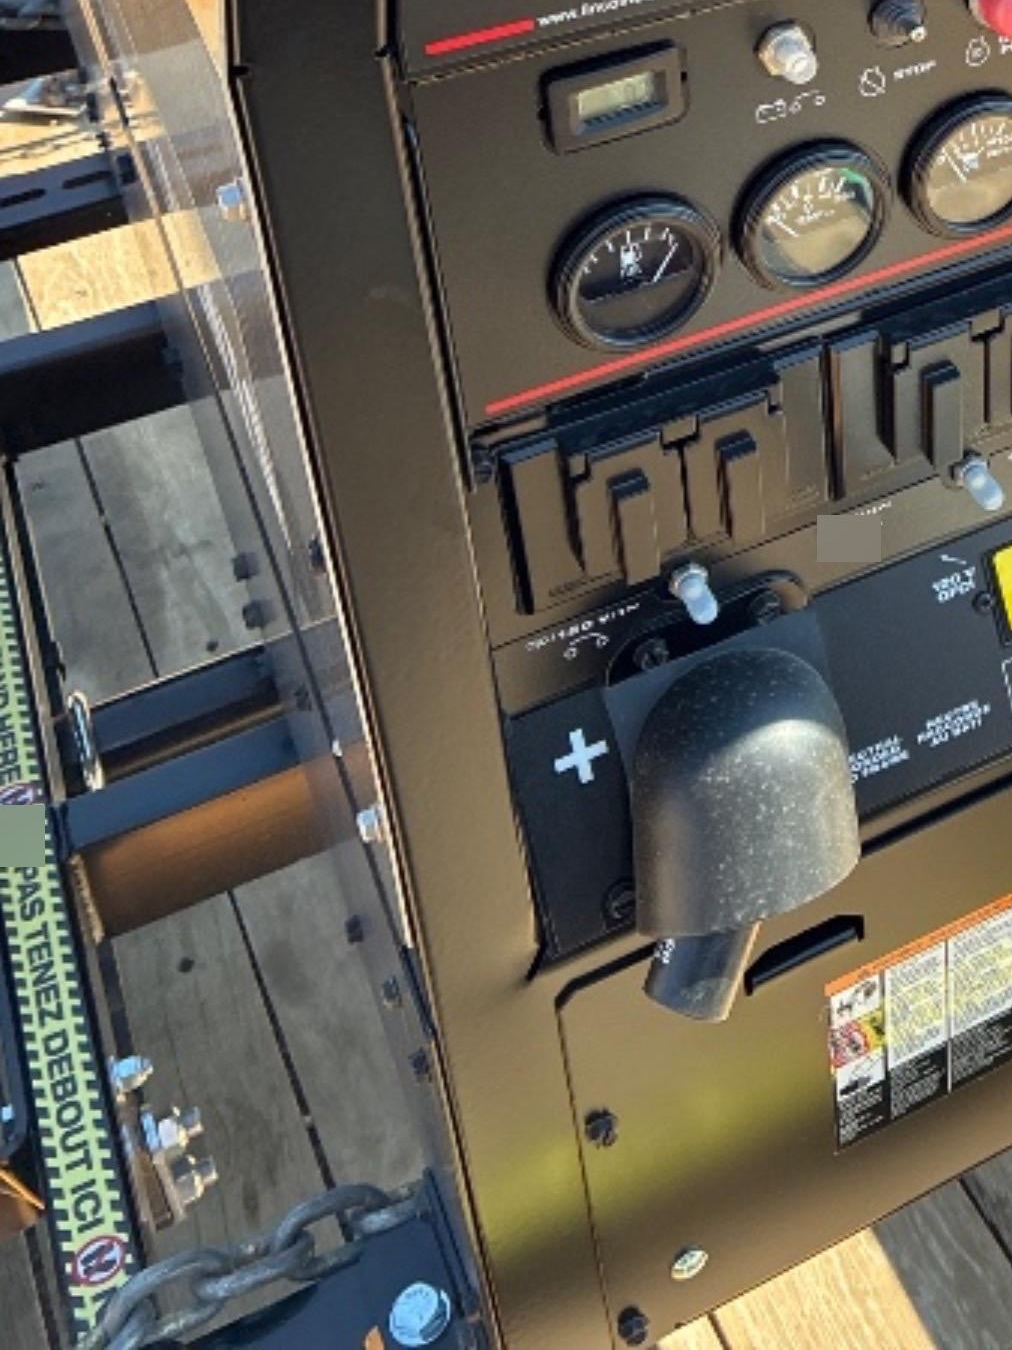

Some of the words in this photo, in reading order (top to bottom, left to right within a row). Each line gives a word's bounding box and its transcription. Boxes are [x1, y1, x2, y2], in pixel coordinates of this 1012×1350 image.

[16, 867, 44, 922] PAS
[25, 924, 65, 1029] TENEZ
[42, 1028, 92, 1172] DEBOUT
[71, 1177, 106, 1234] ICI
